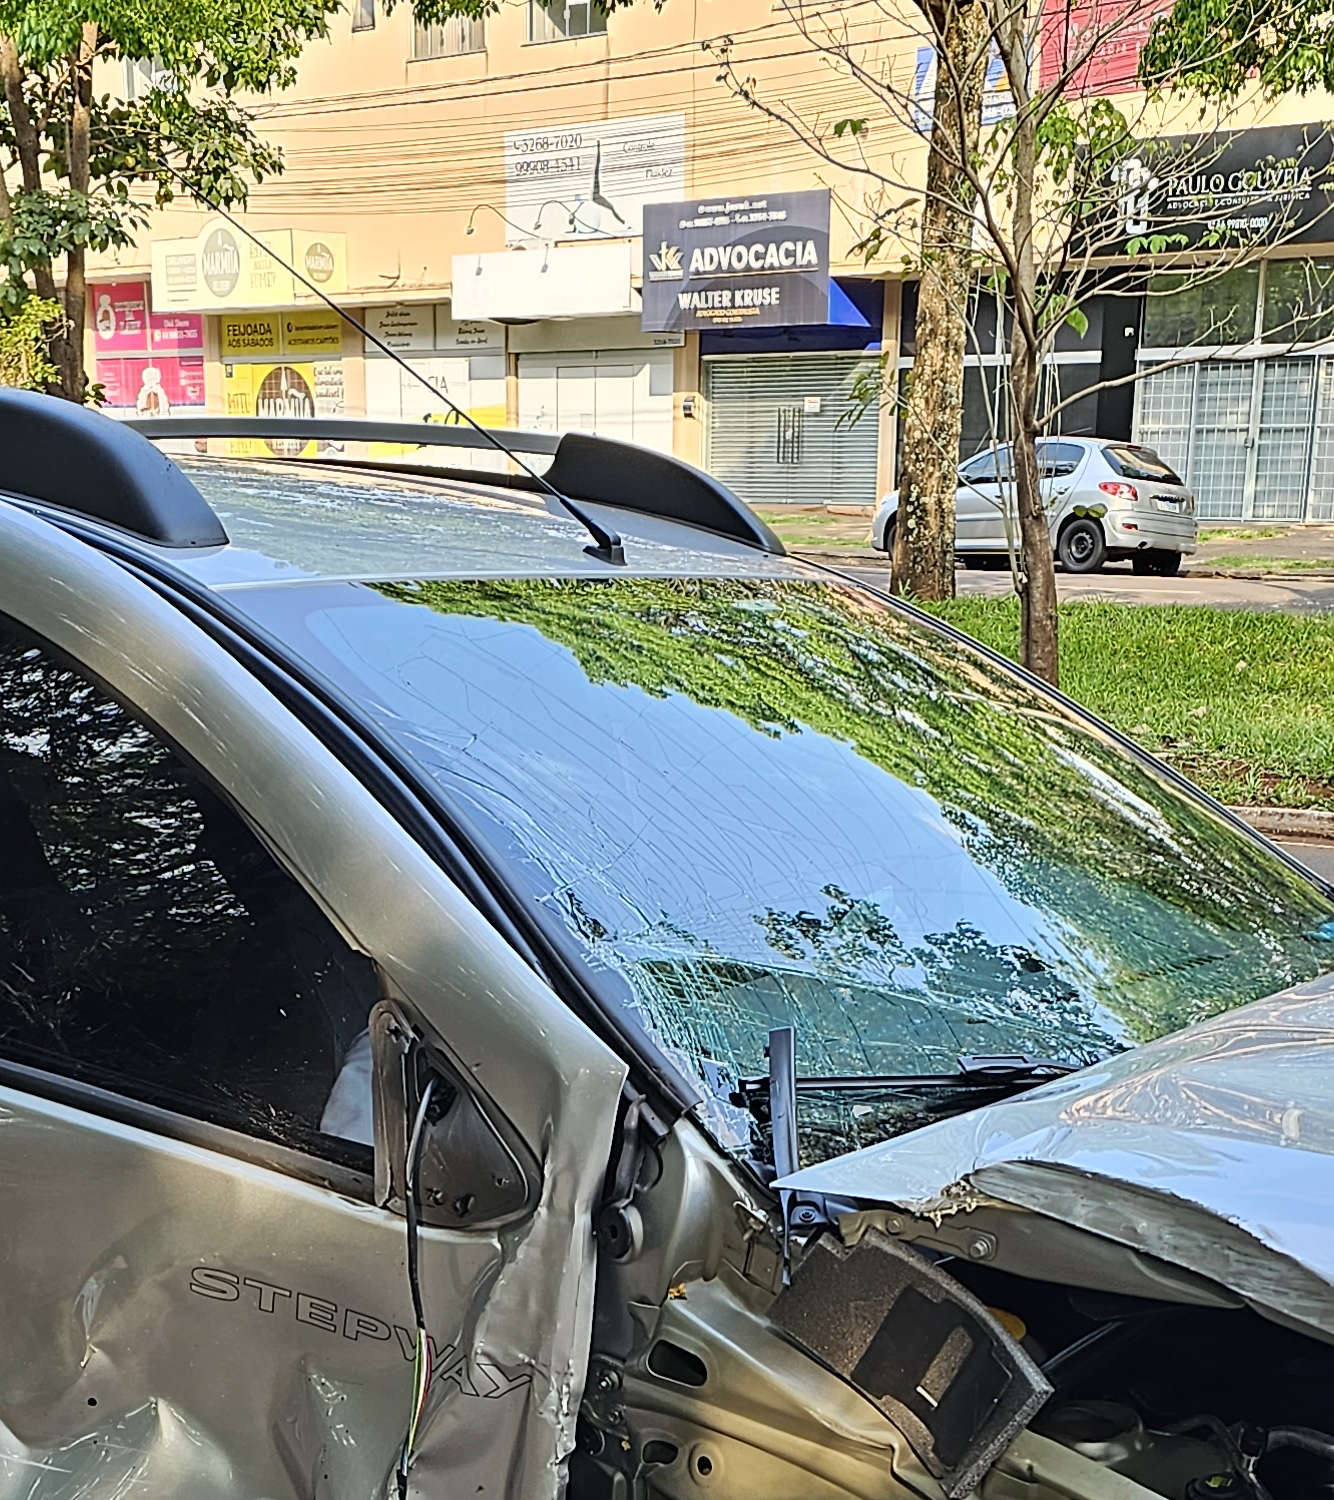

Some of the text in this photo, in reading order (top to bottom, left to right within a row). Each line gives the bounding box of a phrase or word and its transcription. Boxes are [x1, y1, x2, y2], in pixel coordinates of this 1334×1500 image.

[1166, 173, 1225, 197] PAULO
[689, 240, 819, 272] ADVOCACIA
[678, 287, 780, 310] WALTER KRUSE
[227, 323, 272, 337] FEIJOADA
[228, 339, 242, 348] AOS
[258, 392, 313, 417] MARMITA
[189, 1265, 534, 1399] STEPWAY
